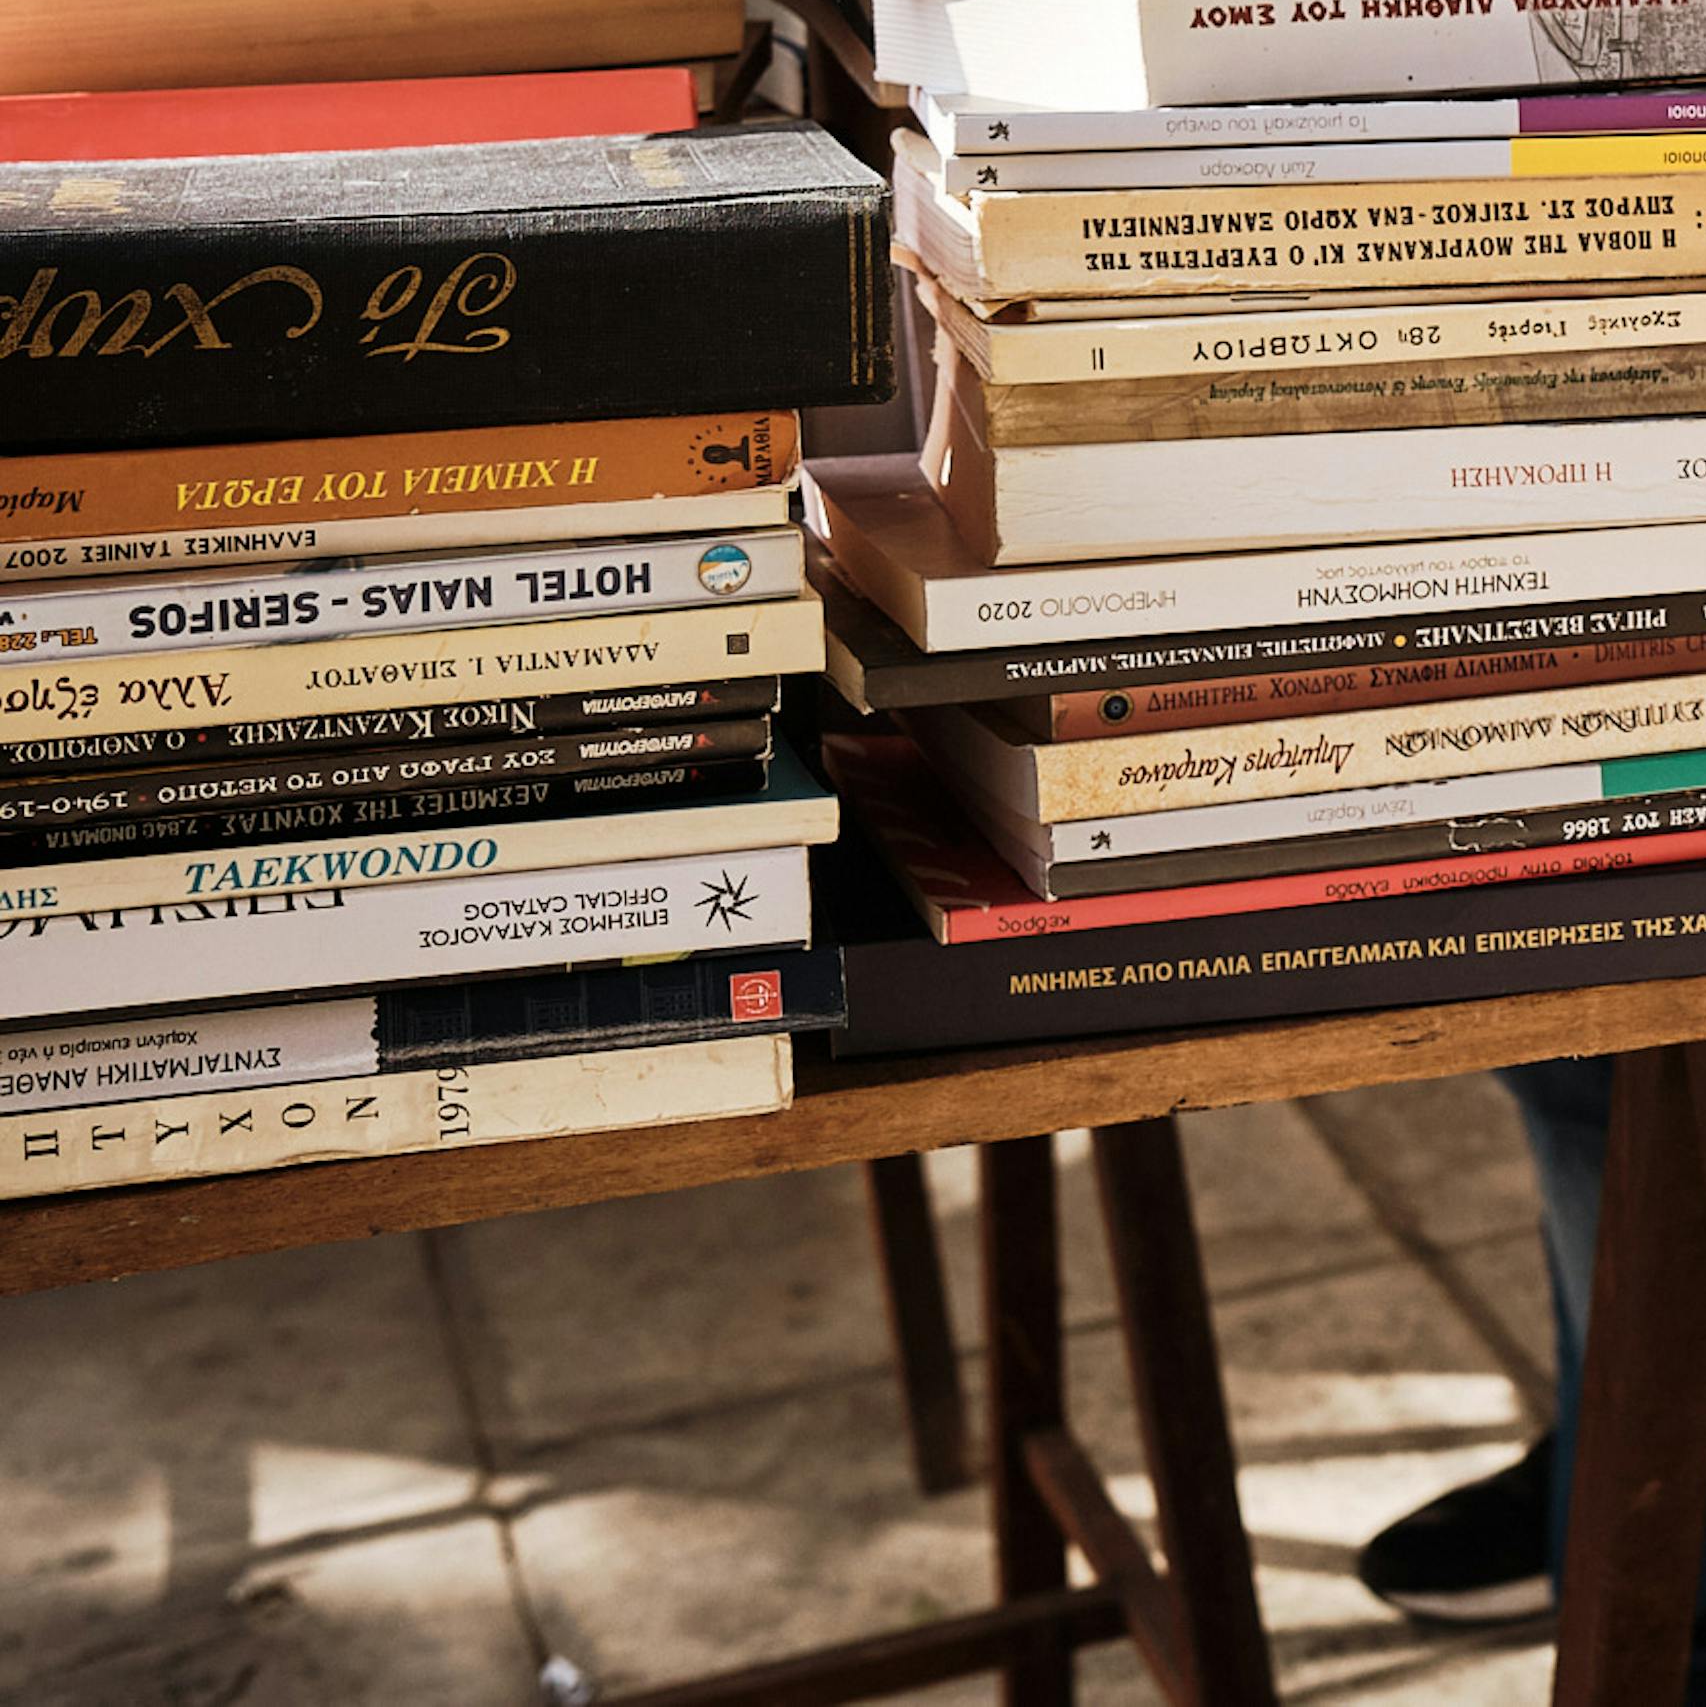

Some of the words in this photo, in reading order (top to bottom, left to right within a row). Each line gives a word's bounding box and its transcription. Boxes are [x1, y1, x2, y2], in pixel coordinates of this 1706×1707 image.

[1189, 3, 1276, 28] ΣΜΟΥ
[1228, 117, 1256, 132] του
[1541, 199, 1575, 220] ΣΤ.
[1585, 195, 1674, 217] ΣΠΥΡΟΣ
[1082, 212, 1273, 239] ΞΑΝΑΓΕΝΝΙΕΤΑΙ
[1284, 208, 1358, 231] ΧΩΡΙΟ
[1357, 237, 1513, 263] ΜΟΥΡΓΚΑΝΑΣ
[1523, 232, 1567, 255] ΤΗΣ
[1578, 229, 1651, 252] ΠΟΒΛΑ
[1662, 228, 1676, 249] Η
[1085, 252, 1130, 271] ΤΗΣ
[1139, 246, 1277, 270] ΕΥΕΡΓΕΤΗΣ
[1289, 244, 1305, 265] Ο
[1192, 330, 1377, 361] ΟΚΤΩΒΡΙΟΥ
[403, 459, 560, 497] ΧΗΜΕΙΑ
[569, 456, 599, 485] Η
[1451, 464, 1586, 489] ΠΡΟΚΛΗΣΗ
[1596, 461, 1612, 482] Η
[175, 475, 304, 512] ΕΡΩΤΑ
[313, 470, 388, 500] ΤΟΥ
[81, 540, 172, 563] ΤΑΙΝΙΕΣ
[184, 529, 316, 556] ΕΛΛΗΝΙΚΕΣ
[5, 547, 68, 569] 2007
[361, 574, 493, 618] NAIAS
[516, 562, 651, 604] HOTEL
[1297, 577, 1448, 608] ΝΟΗΜΟΣΥΝΗ
[1452, 571, 1550, 600] ΤΕΧΝΗΤΗ
[128, 589, 320, 639] SERIFOS
[977, 598, 1032, 622] 2020
[1040, 588, 1177, 616] ΗΜΕΡΟΛΟΓΙΟ
[1589, 606, 1667, 629] ΡΗΓΑΣ
[1414, 614, 1584, 648] ΒΕΛΕΣΤΙΝΛΗΣ
[496, 640, 660, 672] ΑΔΑΜΑΝΤΙΑ
[1595, 638, 1676, 663] DIMITRIS
[305, 659, 457, 691] ΣΠΑΘΑΤΟΥ
[1005, 654, 1107, 679] ΜΑΡΤΥΡΑΣ
[1147, 683, 1257, 712] ΔΗΜΗΤΡΗΣ
[1270, 674, 1358, 699] ΧΟΝΔΡΟΣ
[1370, 662, 1447, 687] ΣΥΝΑΦΗ
[582, 690, 699, 716] ΕΛΕΥΘΕΡΟΤΥΠΙΑ
[228, 708, 434, 747] ΚΑΖΑΝΤΖΑΚΗΣ
[443, 700, 538, 734] ΝΙΚΟΣ
[169, 731, 186, 748] Ο
[579, 734, 695, 759] ΕΛΕΥΘΕΡΟΤΥΠΙΑ
[398, 753, 494, 780] ΓΡΑΦΩ
[500, 747, 556, 769] ΣΟΥ
[1245, 734, 1355, 777] Δημήτρης
[286, 770, 323, 791] ΤΟ
[332, 763, 390, 787] ΑΠΟ
[158, 774, 279, 805] ΜΕΤΩΠΟ
[411, 782, 550, 813] ΔΕΣΜΩΤΕΣ
[219, 802, 345, 834] ΧΟΥΝΤΑΣ
[352, 798, 402, 822] ΤΗΣ
[1622, 810, 1660, 831] ΤΟΥ
[45, 822, 137, 848] ΟΝΟΜΑΤΑ
[1563, 815, 1612, 839] 1866
[185, 837, 499, 895] TAEKWONDO
[464, 895, 568, 921] CATALOG
[574, 886, 669, 910] OFFICIAL
[419, 920, 552, 948] ΚΑΤΑΛΟΓΟΣ
[559, 908, 669, 935] ΕΠΙΣΗΜΟΣ
[1010, 966, 1117, 995] ΜΝΗΜΕΣ
[1121, 961, 1172, 986] ΑΠΟ
[1178, 955, 1252, 981] ΠΑΛΙΑ
[1261, 939, 1423, 973] ΕΠΑΓΓΕΛΜΑΤΑ
[1428, 935, 1466, 957] ΚΑΙ
[1475, 920, 1625, 954] ΕΠΙΧΕΙΡΗΣΕΙΣ
[1632, 916, 1676, 940] ΤΗΣ
[60, 1034, 131, 1058] ευκαιρία
[136, 1029, 199, 1051] Χαμένη
[97, 1047, 282, 1087] ΣΥΝΤΑΓΜΑΤΙΚΗ
[437, 1067, 470, 1139] 1979
